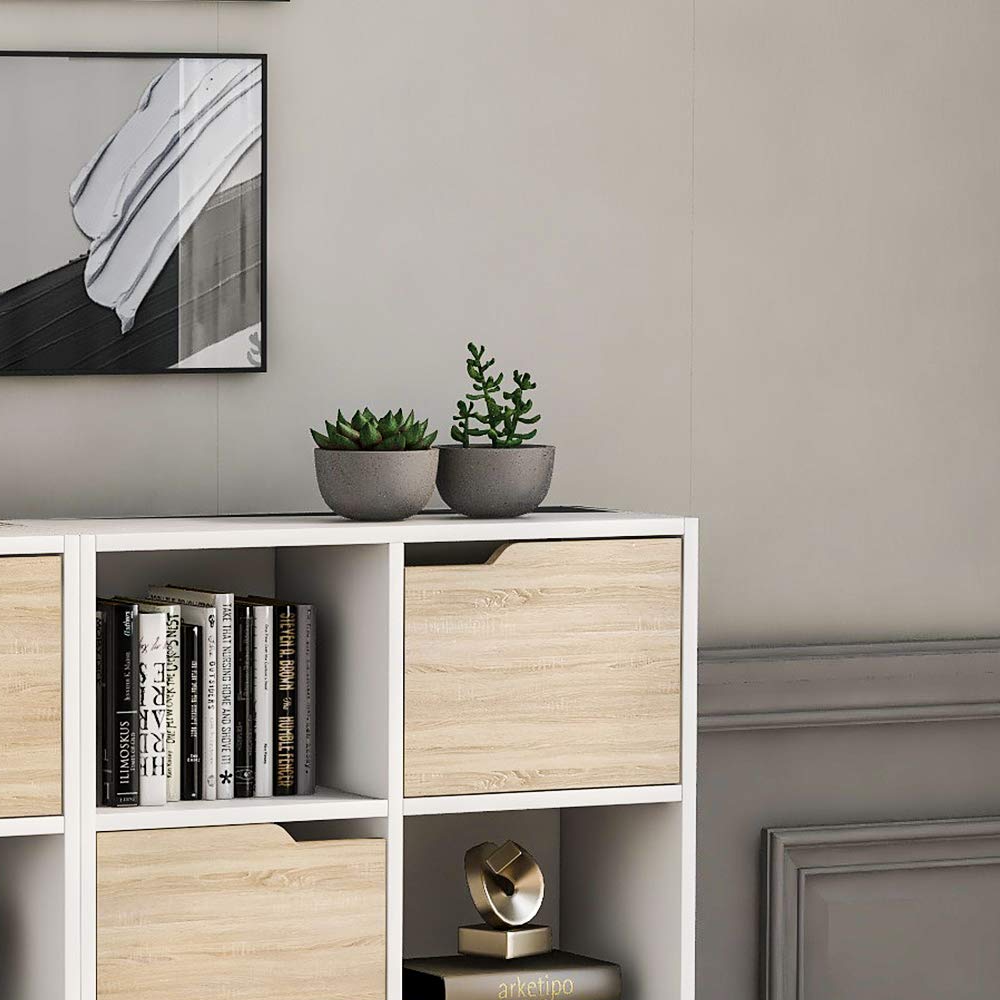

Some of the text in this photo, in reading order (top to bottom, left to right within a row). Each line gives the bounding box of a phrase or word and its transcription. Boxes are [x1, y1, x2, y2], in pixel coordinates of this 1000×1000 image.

[166, 612, 179, 638] NEST
[222, 603, 232, 622] TAKE
[222, 625, 232, 644] THAT
[280, 612, 295, 647] STEVEN
[222, 646, 232, 682] NURSING
[279, 659, 295, 691] BROWN
[208, 661, 216, 710] OUTSIDERS
[222, 684, 232, 705] HOME
[222, 708, 232, 725] AND
[221, 726, 232, 752] SHOVE
[278, 716, 295, 752] HUMBLE
[120, 720, 130, 784] ILIMOSKUS
[278, 753, 295, 787] FENCER
[498, 974, 574, 1000] arketipo
